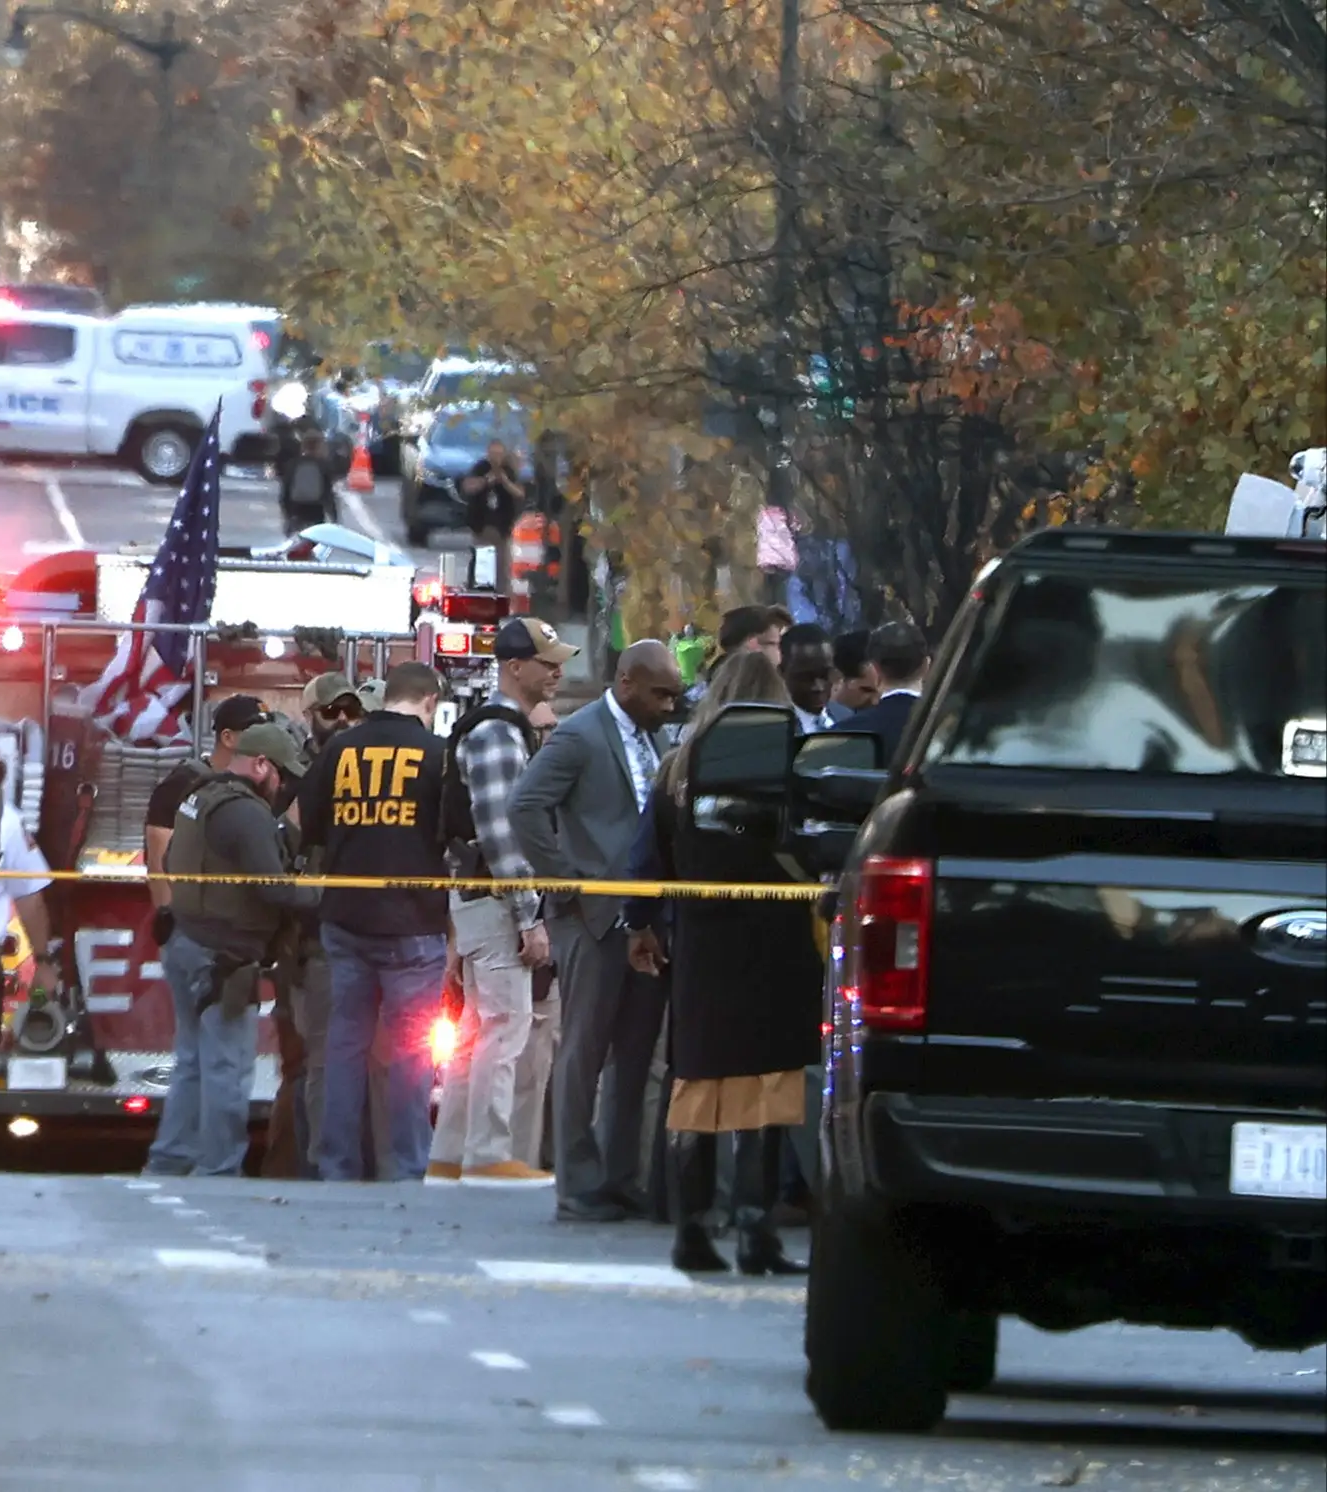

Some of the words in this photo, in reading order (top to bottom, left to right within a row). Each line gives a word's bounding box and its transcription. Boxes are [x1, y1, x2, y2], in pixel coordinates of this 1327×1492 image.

[52, 740, 75, 769] 16
[334, 746, 424, 798] ATF
[334, 800, 416, 826] POLICE
